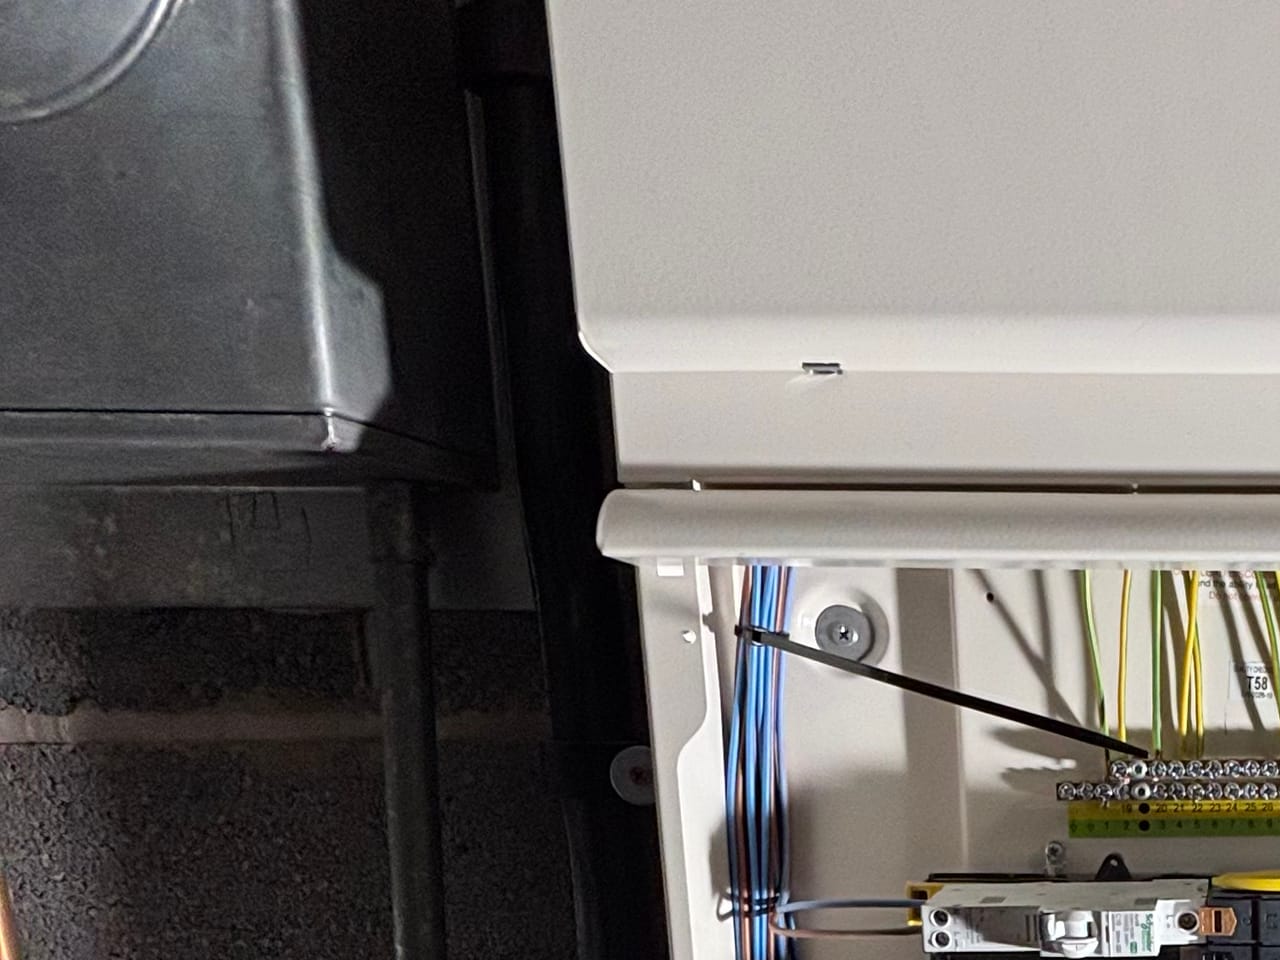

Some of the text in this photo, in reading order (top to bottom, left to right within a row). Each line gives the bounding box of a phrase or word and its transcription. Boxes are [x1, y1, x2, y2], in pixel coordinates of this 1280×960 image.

[1156, 803, 1168, 813] 20
[1174, 803, 1185, 813] 21
[1210, 803, 1221, 812] 23
[1226, 803, 1238, 812] 24
[1245, 802, 1257, 812] 25
